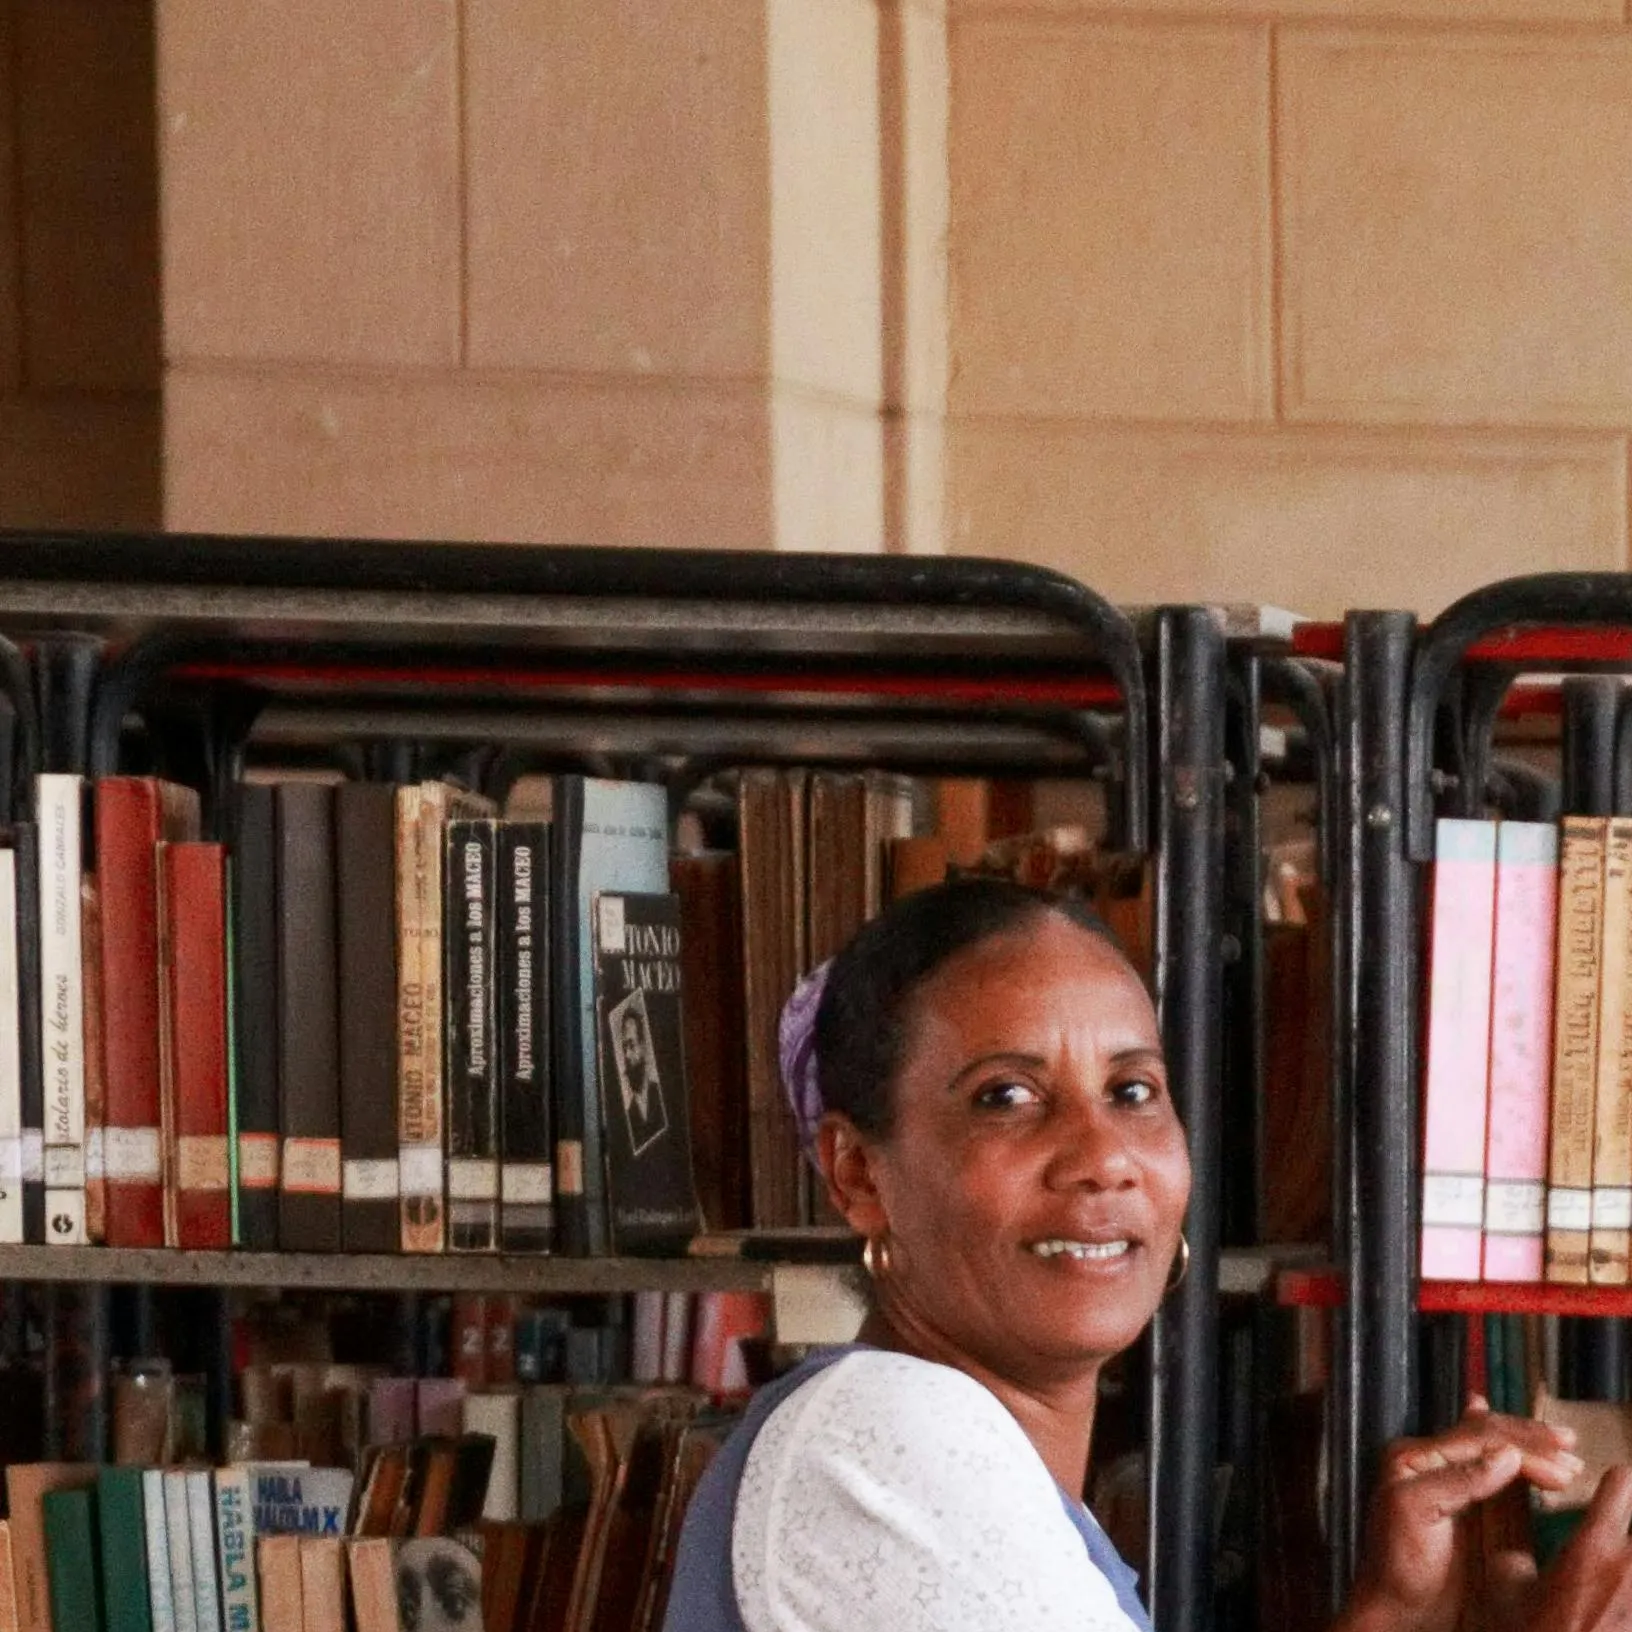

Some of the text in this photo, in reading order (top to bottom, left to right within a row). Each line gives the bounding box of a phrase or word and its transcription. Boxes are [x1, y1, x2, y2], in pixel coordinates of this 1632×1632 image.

[464, 842, 486, 1076] Aproximaciones a los MACEO
[514, 846, 535, 1081] Aproximaciones a los MACEO
[625, 925, 681, 957] TONIO
[52, 1040, 70, 1062] de
[403, 983, 423, 1057] MACEO
[219, 1486, 248, 1592] HABLA
